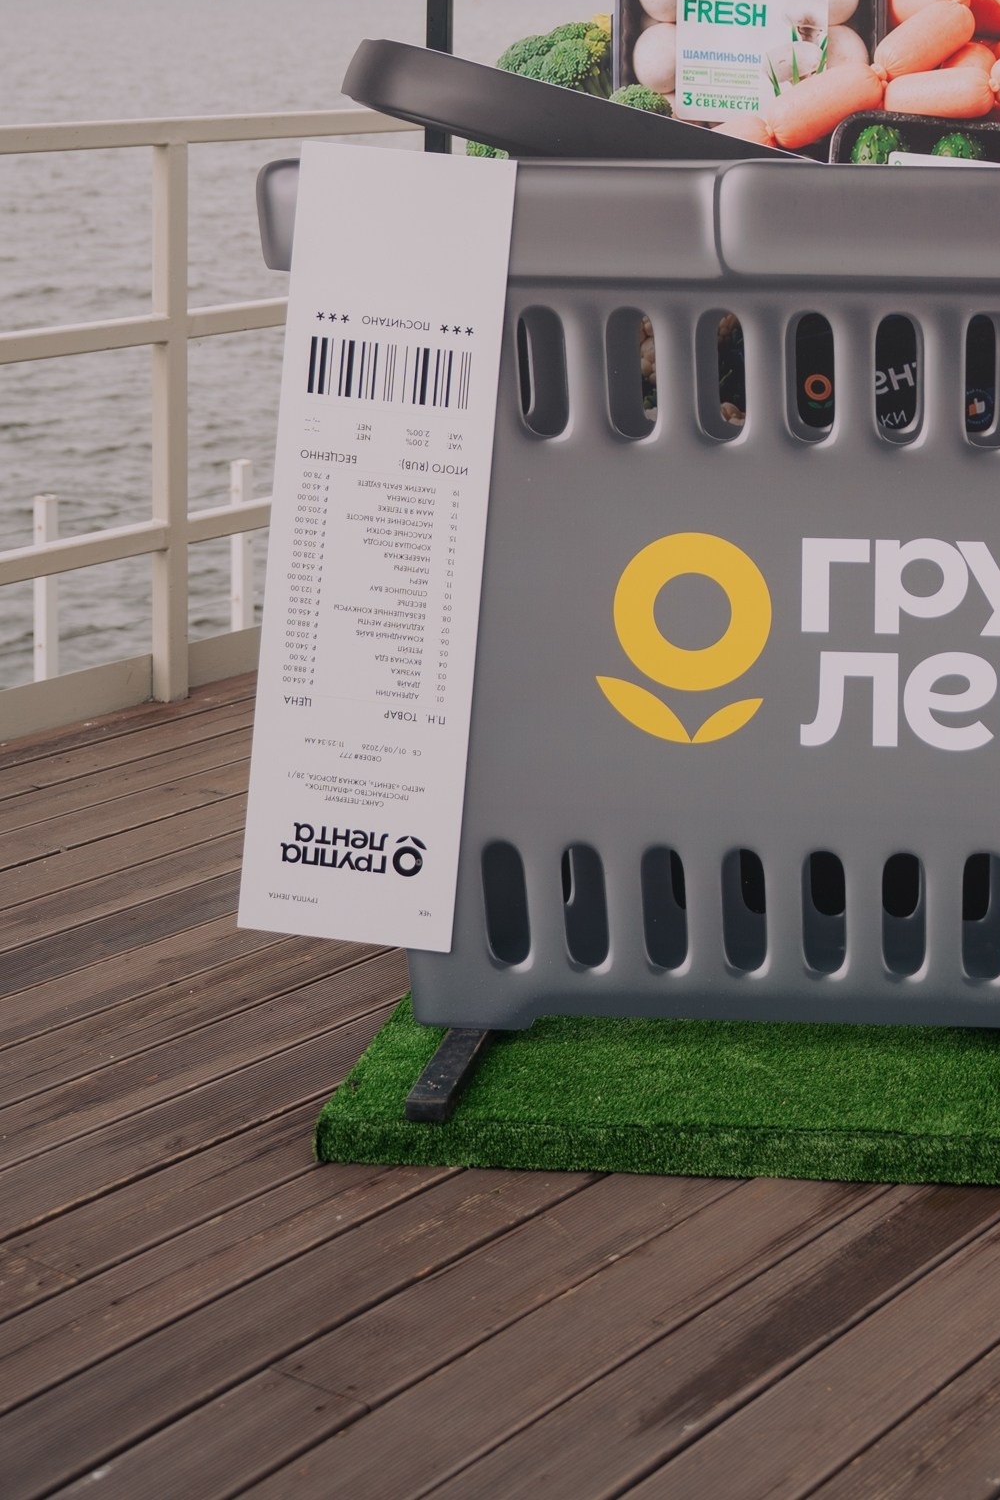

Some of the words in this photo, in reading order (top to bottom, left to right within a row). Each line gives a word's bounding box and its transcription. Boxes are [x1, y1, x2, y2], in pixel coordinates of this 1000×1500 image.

[682, 49, 762, 65] ШАМПИНЬОНЫ
[682, 91, 693, 107] 3
[695, 97, 759, 111] СВЕЖЕСТИ
[361, 315, 430, 331] ПОСЧИТАНО
[876, 362, 917, 395] ен
[879, 410, 907, 427] ки
[406, 428, 430, 437] 2.00%
[405, 438, 429, 447] 2.00%
[446, 442, 462, 450] VAT:
[300, 449, 357, 464] БЕСЦЕННО
[398, 458, 428, 472] (RUB):
[431, 463, 468, 475] ИТОГО
[302, 470, 322, 479] 78.00
[301, 482, 321, 490] 45.00
[357, 479, 381, 488] БУДЕТЕ
[382, 482, 402, 490] БРАТЬ
[403, 484, 436, 494] ПАКЕТИК
[296, 493, 319, 502] 100.00
[386, 494, 416, 503] ОТМЕНА
[417, 497, 435, 505] ГАЛЯ
[377, 504, 402, 513] ТЕЛЕКЕ
[294, 515, 318, 524] 306.00
[346, 512, 373, 522] ВЫСОТЕ
[387, 517, 433, 528] НАСТРОЕНИЕ
[293, 527, 317, 535] 404.00
[366, 526, 392, 535] ФОТКИ
[393, 529, 432, 539] КЛАССНЫЕ
[292, 538, 317, 547] 505.00
[362, 537, 393, 547] ПОГОДА
[394, 541, 431, 551] ХОРОШАЯ
[292, 550, 316, 559] 328.00
[383, 551, 430, 562] НАБЕРЕЖНАЯ
[291, 561, 315, 570] 654.00
[393, 564, 429, 574] ПАРТНЕРЫ
[286, 572, 313, 581] 1200.00
[409, 577, 428, 585] МЕРЧ
[290, 584, 312, 593] 123.00
[384, 586, 427, 597] СПЛОШНОЕ
[288, 595, 312, 604] 328.00
[396, 599, 426, 608] ВЕСЕЛЬЕ
[287, 607, 311, 615] 456.00
[333, 603, 372, 613] КОНКУРСЫ
[373, 607, 425, 620] БЕЗБАШЕННЫЕ
[286, 618, 310, 627] 888.00
[357, 618, 381, 626] МЕЧТЫ
[382, 620, 424, 631] ХЕДЛАЙНЕР
[285, 629, 309, 638] 205.00
[355, 629, 374, 637] ВАЙБ
[375, 631, 423, 642] КОМАНДНЫЙ
[284, 641, 308, 650] 540.00
[397, 645, 423, 654] РЕТЕЙЛ
[288, 653, 307, 661] 76.00
[374, 653, 388, 662] ЕДА
[389, 656, 422, 665] ВКУСНАЯ
[282, 664, 307, 673] 888.00
[390, 667, 421, 676] МУЗЫКА
[282, 675, 306, 684] 654.00
[396, 679, 420, 688] ДРАЙВ
[375, 689, 419, 699] АДРЕНАЛИН
[283, 694, 311, 707] ЦЕНА
[383, 709, 416, 721] ТОВАР
[425, 714, 445, 725] П.Н.
[361, 743, 406, 754] 01/08/2026
[338, 751, 352, 759] 777
[306, 772, 337, 783] ДОРОГА,
[338, 777, 366, 786] ЮЖНАЯ
[401, 784, 425, 792] МЕТРО
[353, 788, 409, 800] ПРОСТРАНСТВО
[323, 794, 384, 807] САНКТ-ПЕТЕРБУРГ
[293, 821, 388, 851] лента
[280, 842, 387, 874] группа
[268, 892, 290, 900] ЛЕНТА
[291, 894, 318, 903] ГРУППА
